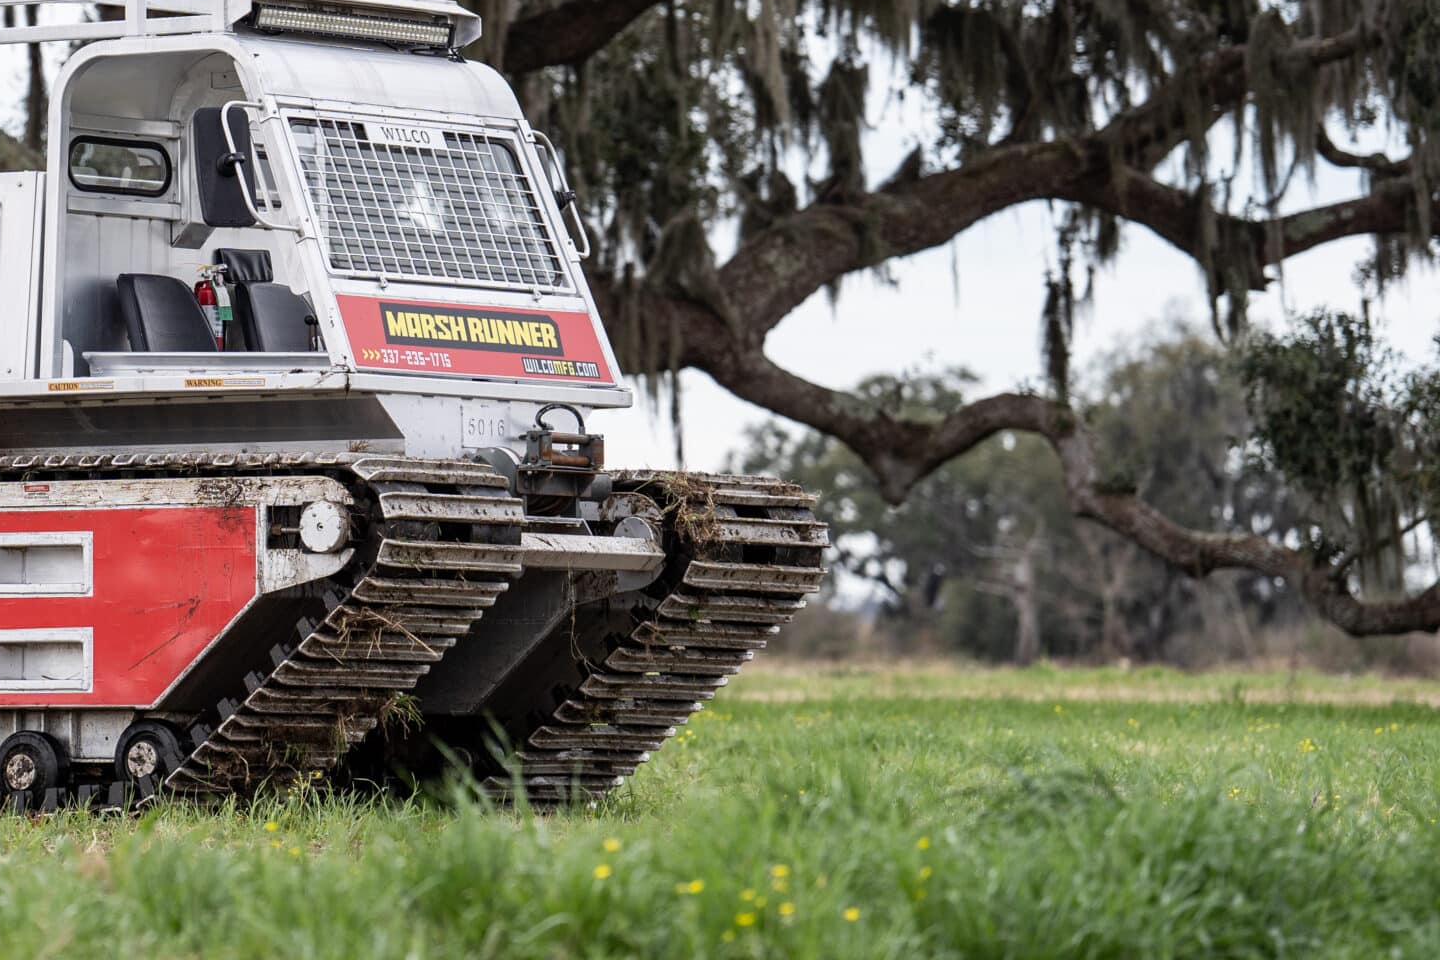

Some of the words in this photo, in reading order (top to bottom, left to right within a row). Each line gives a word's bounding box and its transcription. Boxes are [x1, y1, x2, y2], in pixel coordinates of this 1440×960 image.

[380, 126, 430, 144] WILCO
[385, 311, 467, 342] MARSH
[468, 317, 558, 349] RUNNER
[523, 357, 599, 378] WILCOMFG.COM
